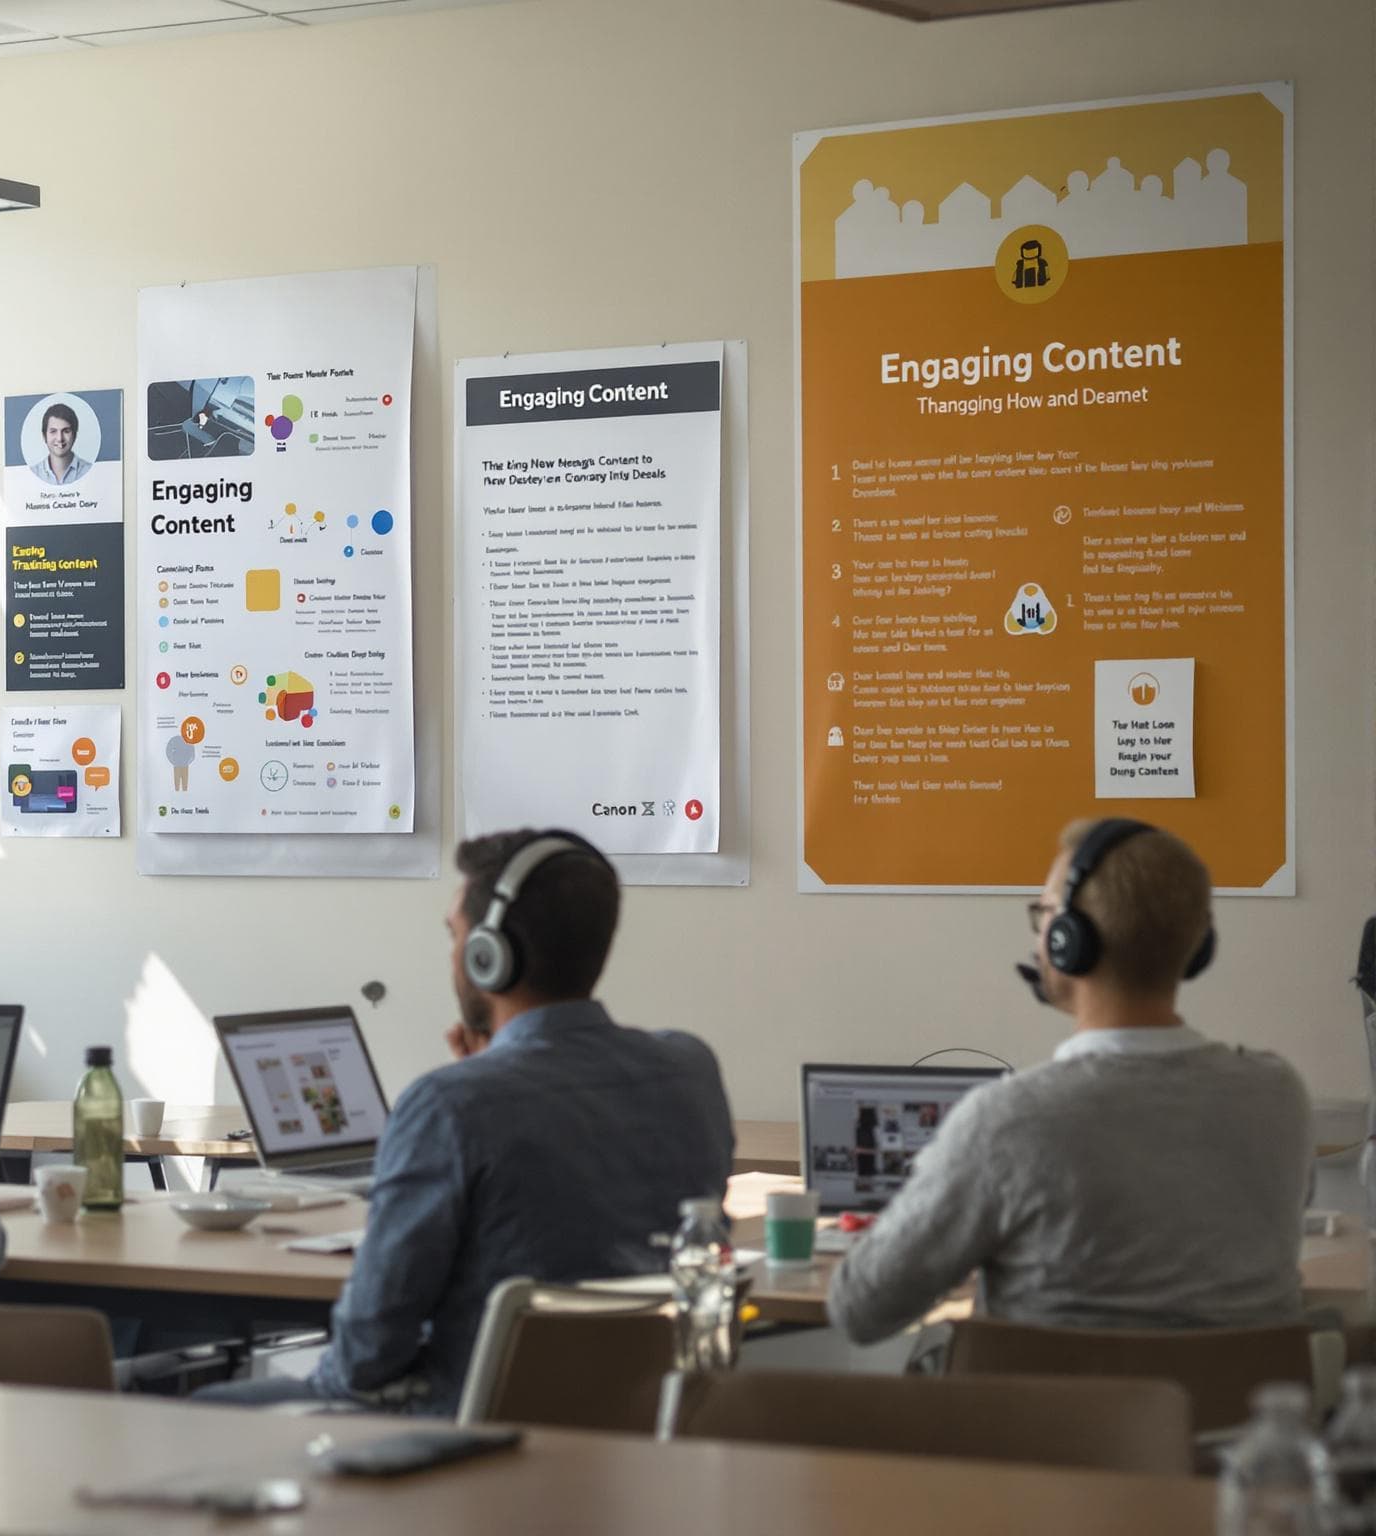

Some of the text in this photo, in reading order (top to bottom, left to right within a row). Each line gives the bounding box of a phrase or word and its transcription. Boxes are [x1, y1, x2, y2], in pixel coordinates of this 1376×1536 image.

[881, 337, 1182, 389] Engaging Content
[499, 381, 669, 411] Engaging Content
[917, 395, 1002, 416] Thangging
[1007, 393, 1043, 409] How
[1047, 388, 1078, 408] and
[831, 464, 841, 481] 1
[152, 478, 253, 504] Engaging
[151, 514, 236, 535] Content
[831, 519, 842, 532] 2
[831, 563, 842, 579] 3
[592, 803, 637, 816] Canon
